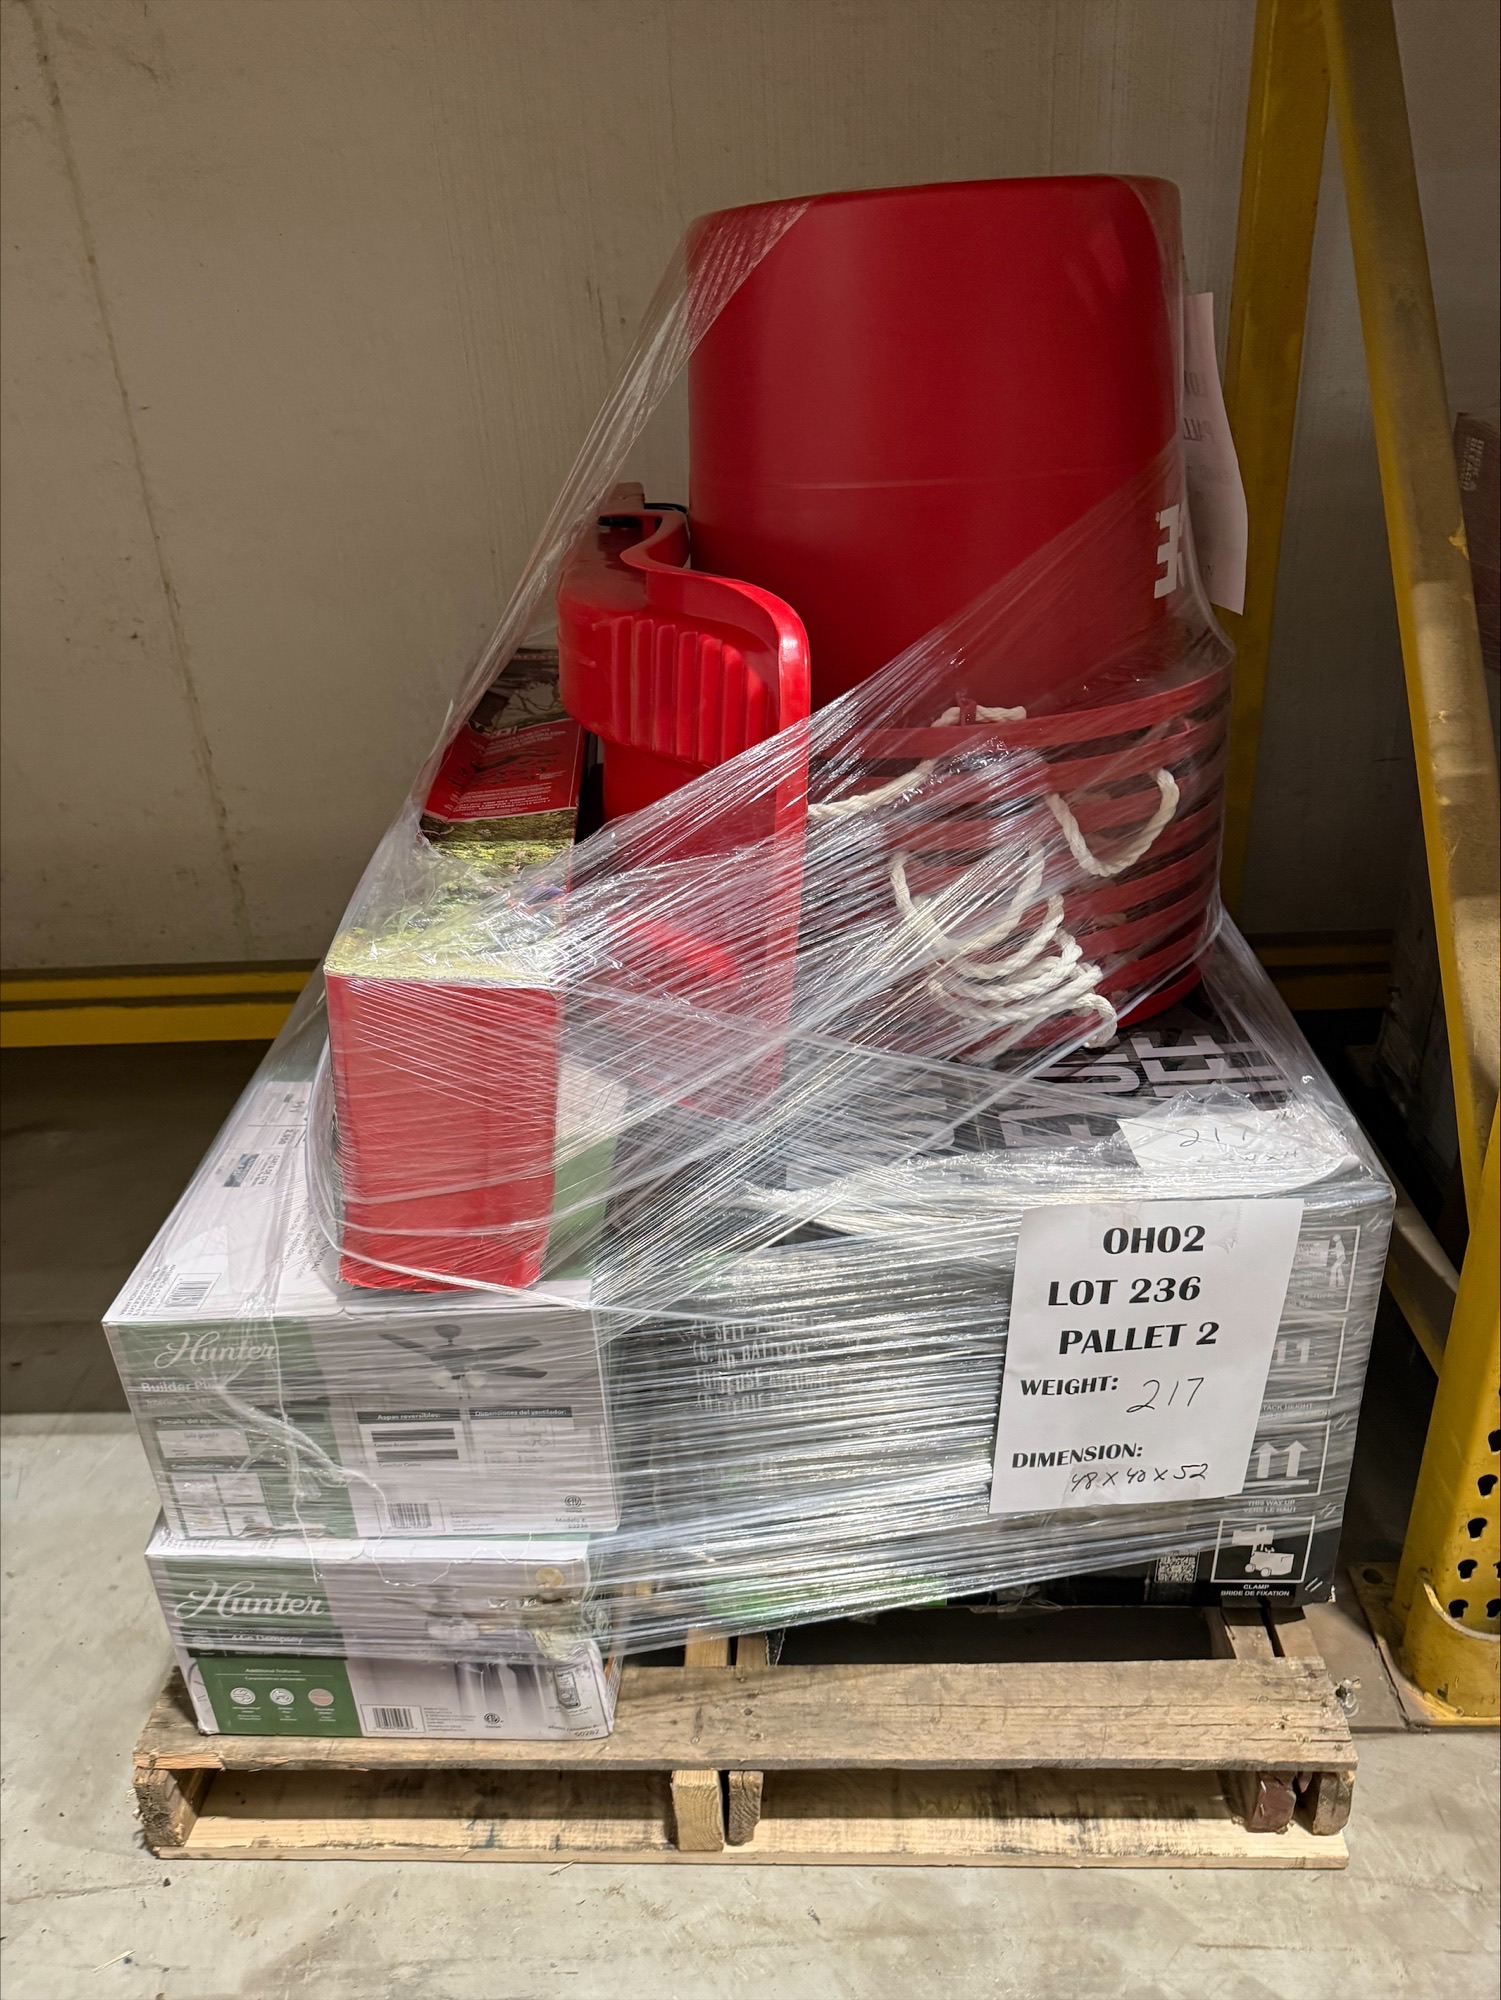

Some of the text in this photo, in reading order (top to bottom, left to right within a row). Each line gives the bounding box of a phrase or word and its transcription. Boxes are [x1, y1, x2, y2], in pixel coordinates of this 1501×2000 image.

[1104, 1226, 1205, 1254] OH02
[1049, 1277, 1200, 1305] LOT 236
[154, 1330, 279, 1369] Hunter
[1059, 1322, 1219, 1354] PALLET 2
[141, 1381, 191, 1392] Builder
[1021, 1376, 1118, 1395] WEIGHT:
[1126, 1377, 1204, 1413] 217
[1259, 1403, 1282, 1411] TACK
[1012, 1443, 1143, 1468] DIMENSION:
[1072, 1472, 1098, 1491] 48
[1174, 1464, 1208, 1479] 52
[173, 1579, 324, 1620] Hunter
